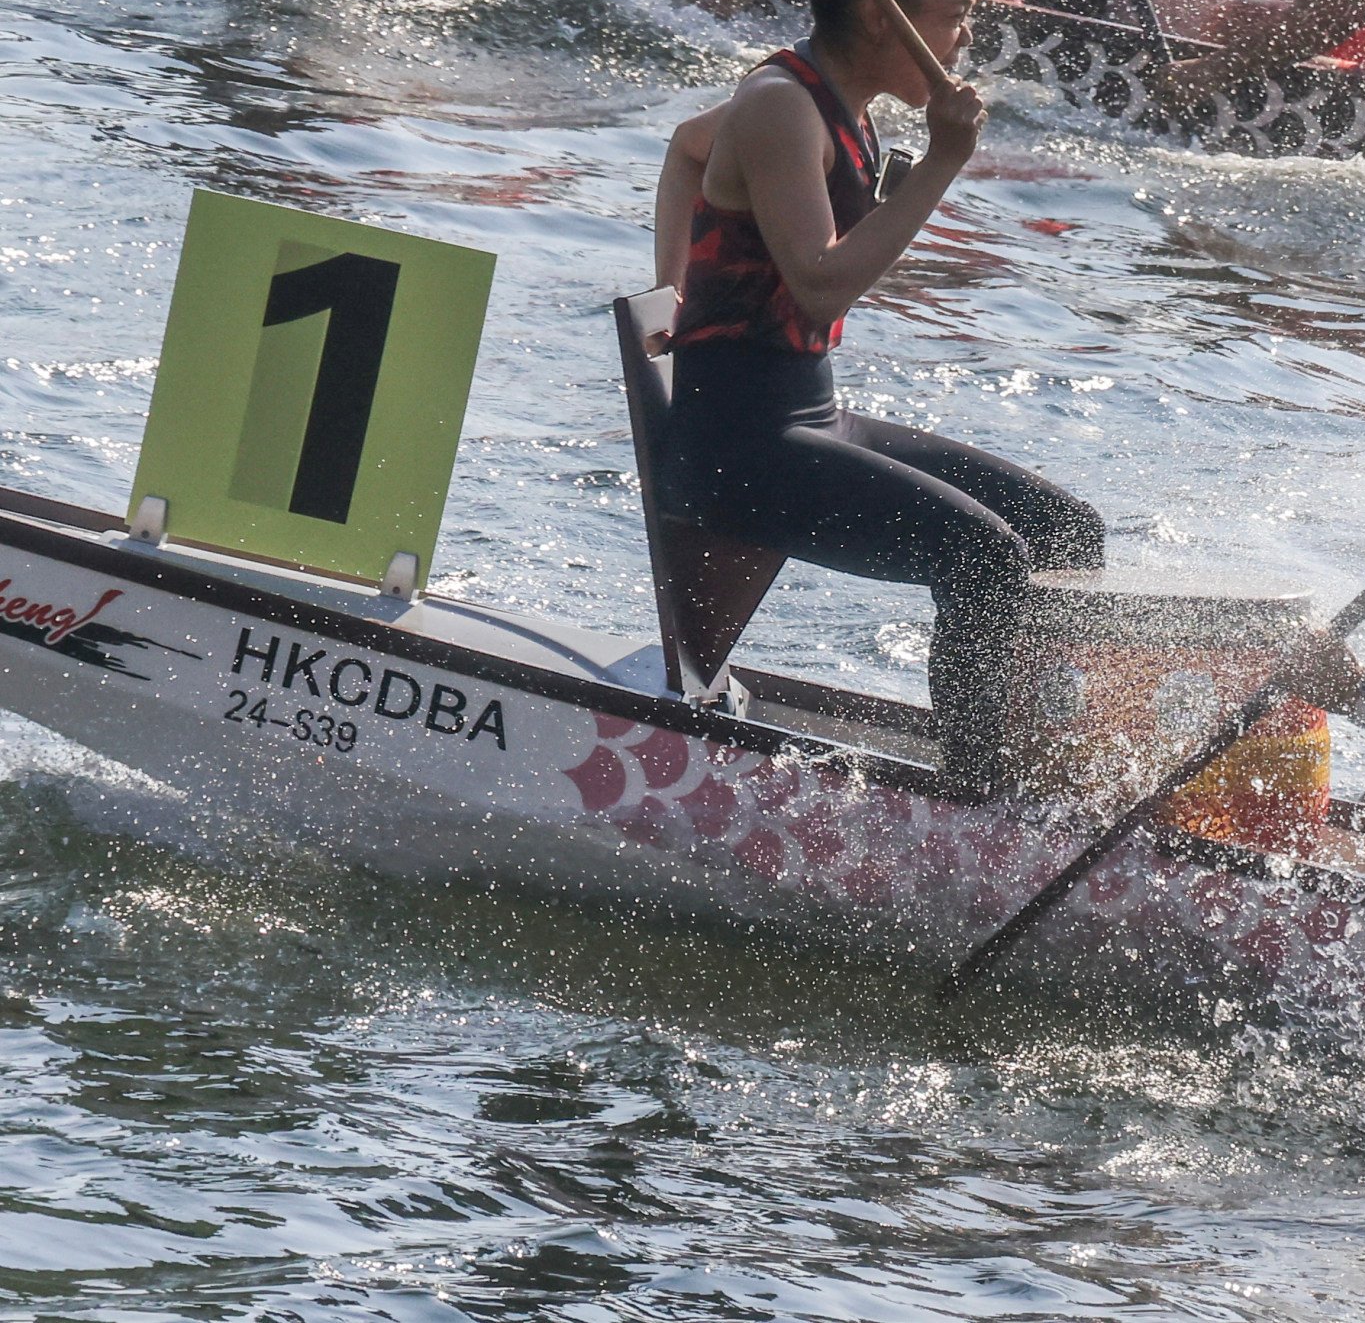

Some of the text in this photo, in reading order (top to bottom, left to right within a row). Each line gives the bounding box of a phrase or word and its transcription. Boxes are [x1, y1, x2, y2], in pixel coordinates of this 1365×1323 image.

[262, 252, 401, 525] 1
[223, 689, 359, 753] 24-S39
[231, 627, 508, 751] HKCDBA
